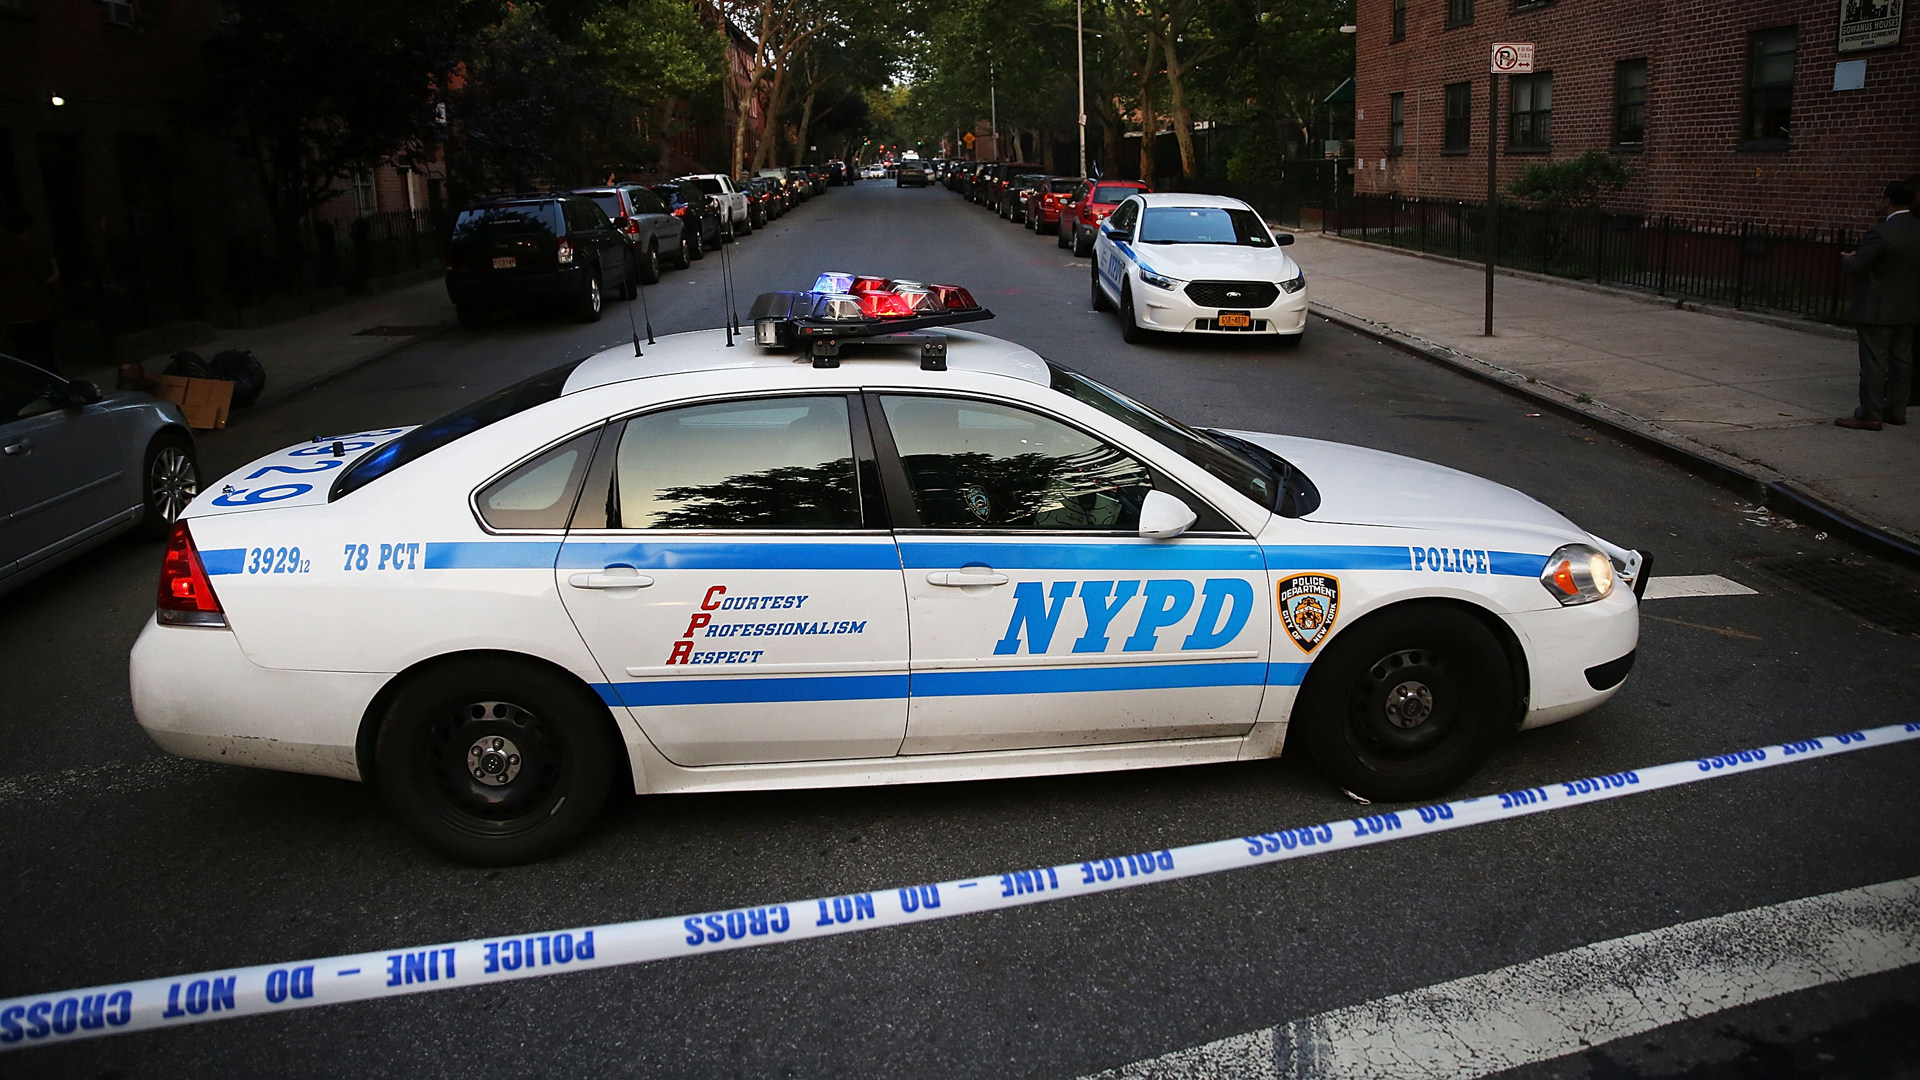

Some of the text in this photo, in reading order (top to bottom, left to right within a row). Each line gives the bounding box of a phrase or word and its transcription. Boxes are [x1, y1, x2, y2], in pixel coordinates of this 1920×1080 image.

[1874, 18, 1899, 30] HOUSES
[343, 542, 420, 572] 78 PCT
[1411, 546, 1488, 575] POLICE
[700, 585, 810, 611] COURTESY
[1281, 585, 1337, 602] DEPARTMENT
[1292, 576, 1326, 588] POLICE
[682, 612, 868, 639] PROFESSIONALISM
[992, 577, 1255, 656] NYPD
[1282, 602, 1337, 644] CITY OF NEW YORK
[665, 640, 764, 666] RESPECT
[1242, 823, 1333, 857] CROSS
[1000, 866, 1059, 898] LINE
[1080, 849, 1175, 885] POLICE
[815, 892, 876, 927] NOT
[898, 883, 942, 914] DO
[683, 905, 791, 947] CROSS
[386, 947, 456, 988] LINE
[483, 930, 596, 974] POLICE
[162, 975, 237, 1020] NOT
[265, 965, 315, 1004] DO
[0, 989, 133, 1044] CROSS
